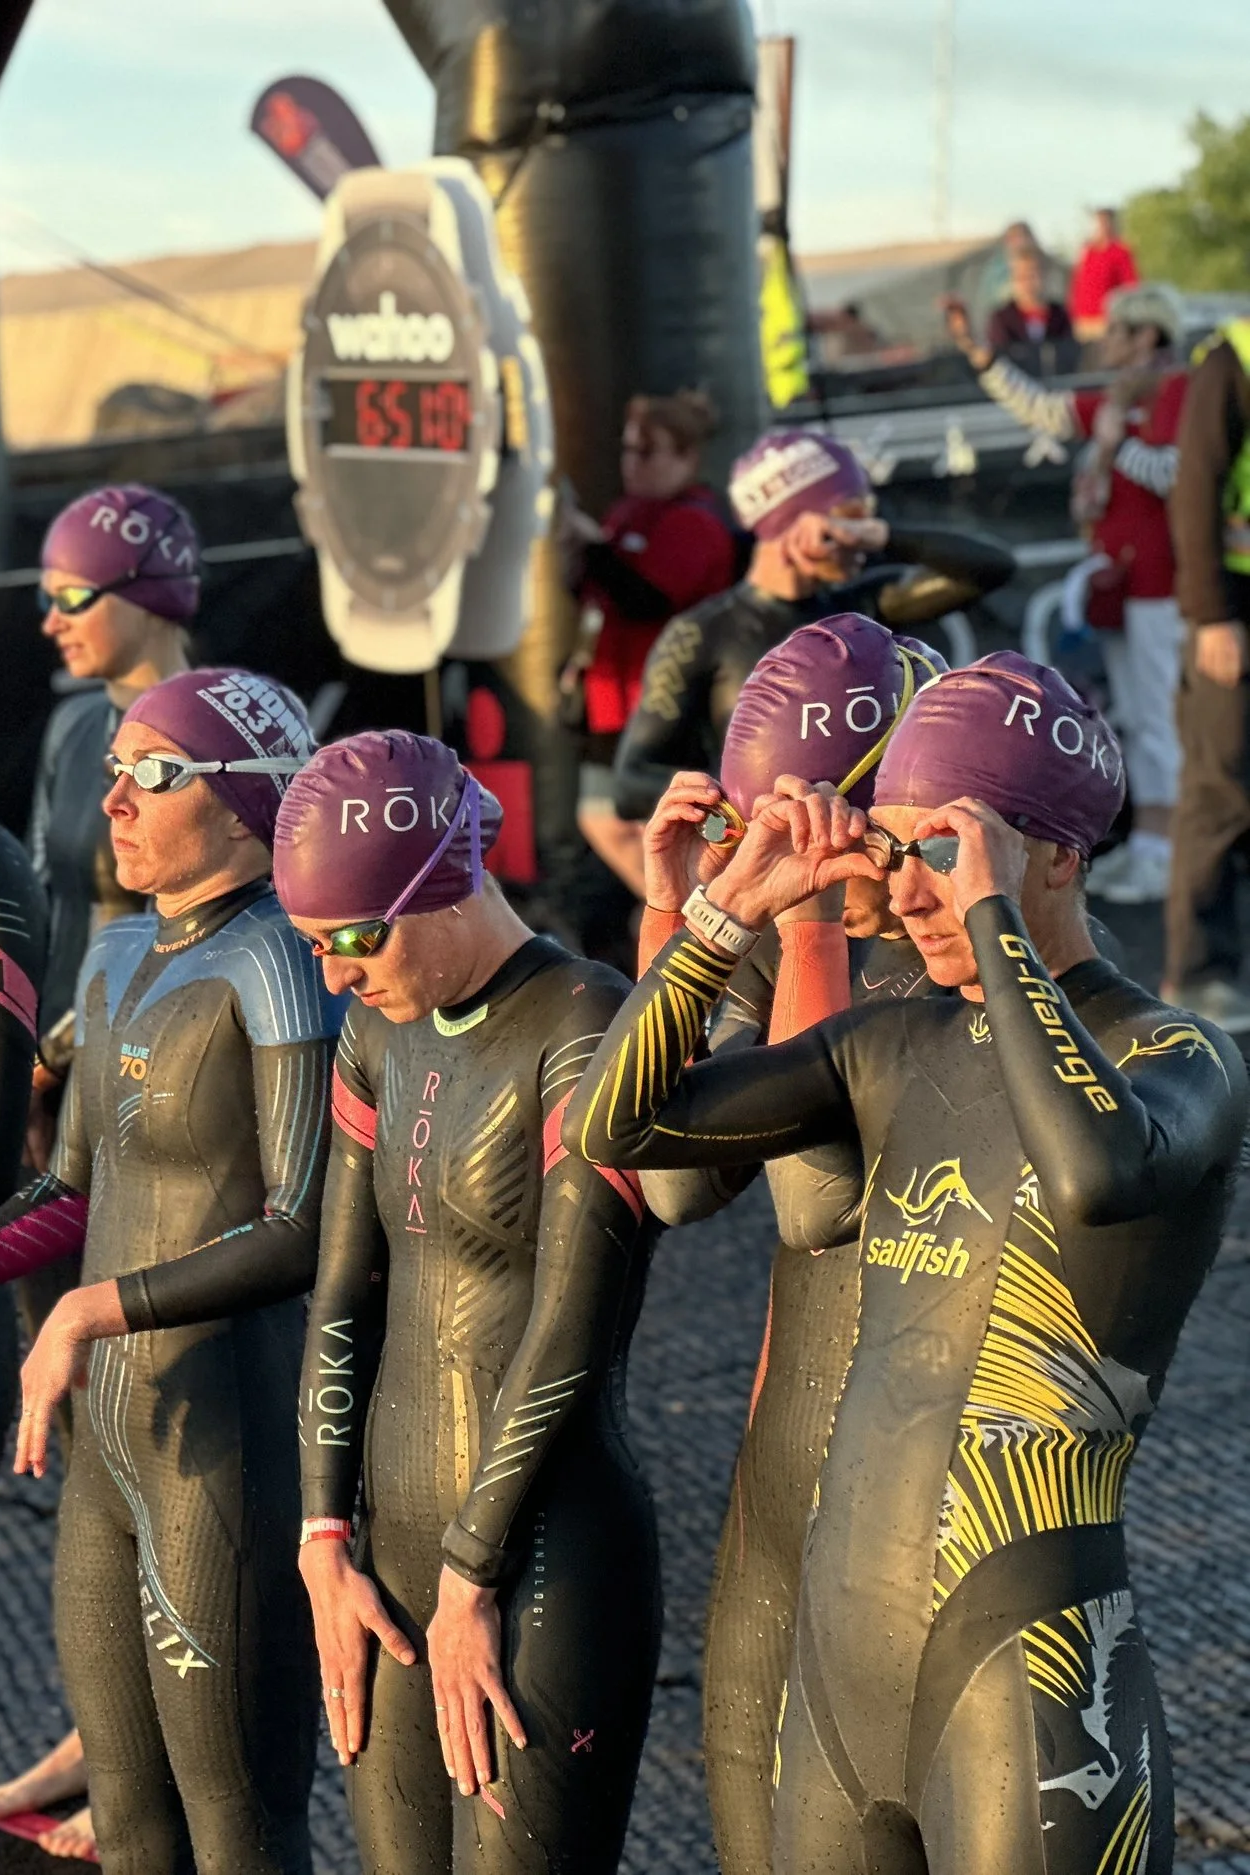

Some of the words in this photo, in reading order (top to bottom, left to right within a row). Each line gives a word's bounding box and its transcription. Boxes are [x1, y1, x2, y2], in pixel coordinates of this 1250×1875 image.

[329, 290, 454, 363] wahoo
[200, 690, 232, 719] NORTH
[232, 719, 269, 760] AMERICA
[207, 678, 272, 734] 70.3
[154, 927, 206, 954] SEVENTY
[999, 934, 1119, 1113] G-Range
[119, 1055, 147, 1081] 70
[121, 1043, 150, 1060] BLUE
[686, 1132, 709, 1140] zero
[866, 1230, 970, 1285] sailfish
[136, 1569, 210, 1680] ELIX
